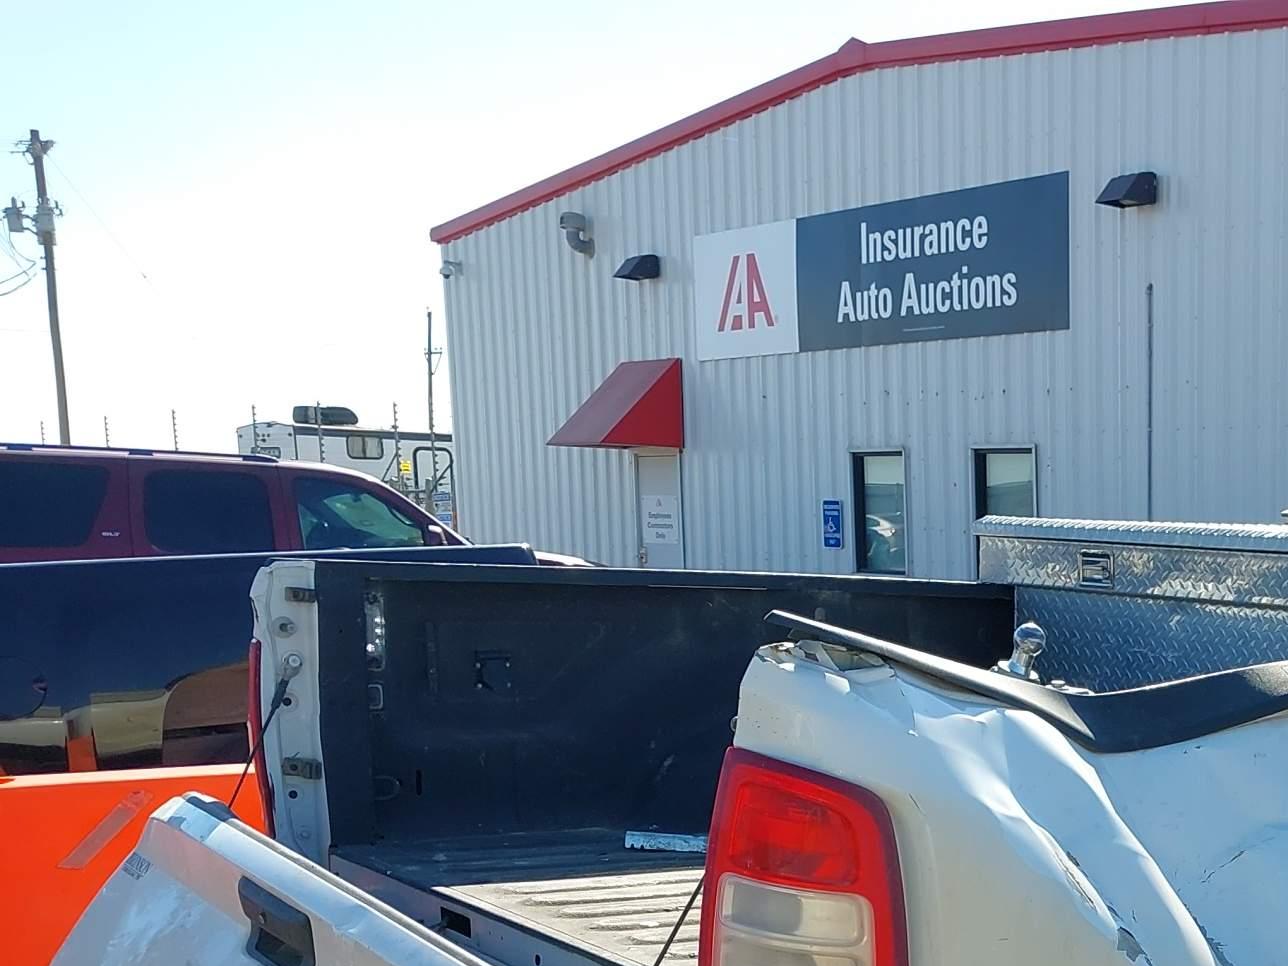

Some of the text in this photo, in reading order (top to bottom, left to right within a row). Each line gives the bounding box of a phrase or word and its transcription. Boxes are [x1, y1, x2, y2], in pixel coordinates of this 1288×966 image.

[860, 215, 988, 264] Insurance
[836, 265, 1017, 323] Auto Auctions
